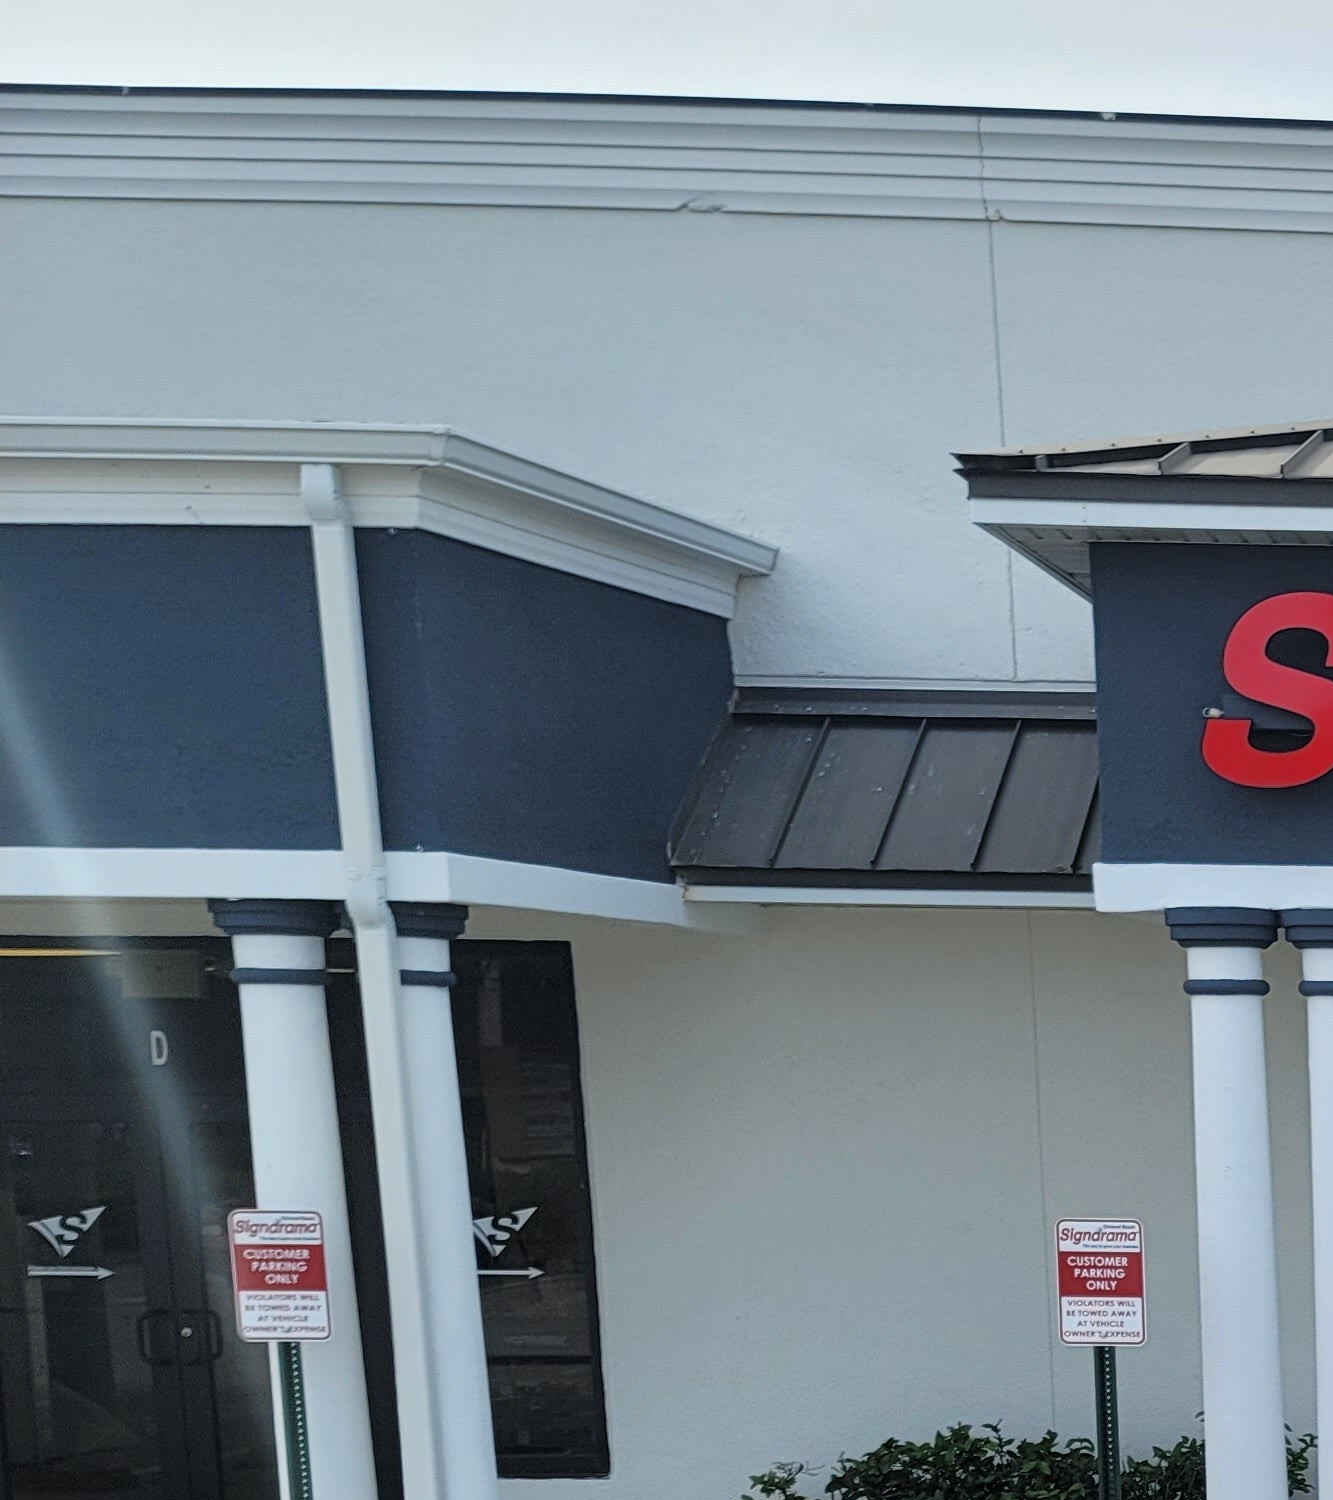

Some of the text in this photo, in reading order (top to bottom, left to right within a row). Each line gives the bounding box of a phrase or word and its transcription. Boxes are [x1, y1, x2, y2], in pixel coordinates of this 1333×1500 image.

[150, 1030, 169, 1066] D
[232, 1220, 319, 1237] Signarama
[1060, 1227, 1137, 1245] Signarama
[243, 1249, 310, 1259] CUSTOMER
[1067, 1256, 1128, 1266] CUSTOMER
[251, 1261, 308, 1272] PARKING
[1074, 1269, 1125, 1278] PARKING
[264, 1274, 299, 1284] ONLY
[1086, 1280, 1117, 1290] ONLY
